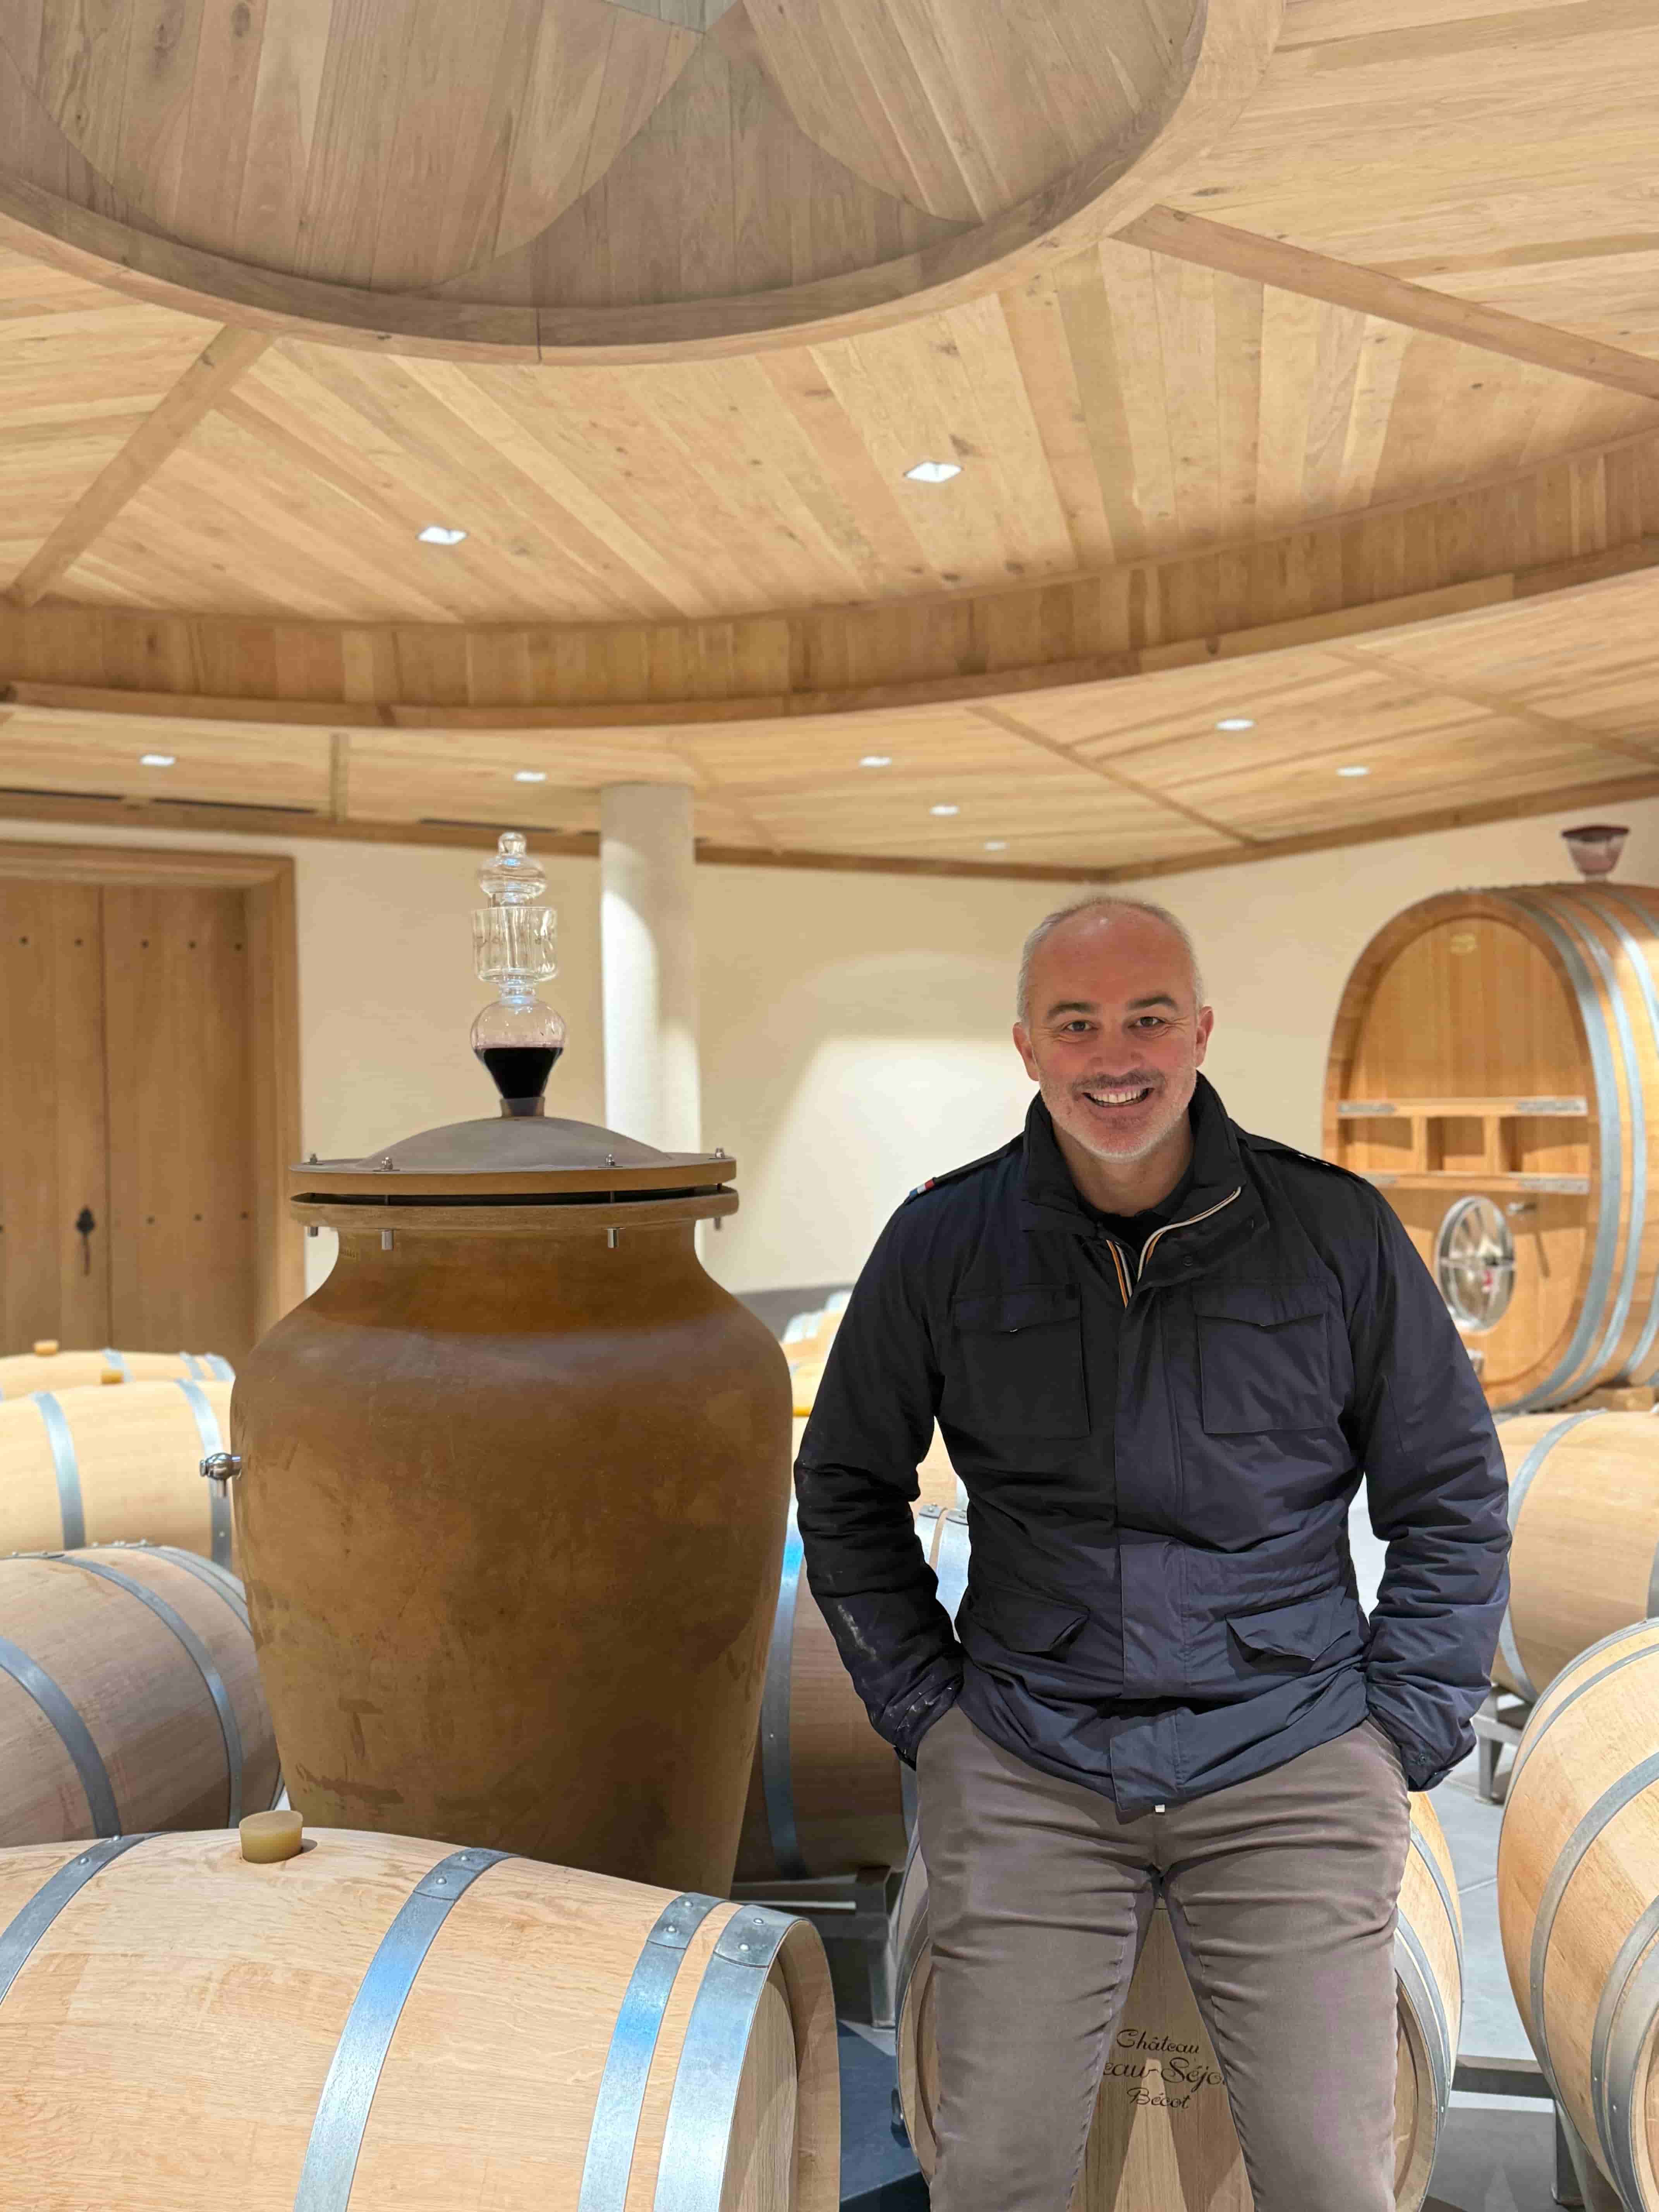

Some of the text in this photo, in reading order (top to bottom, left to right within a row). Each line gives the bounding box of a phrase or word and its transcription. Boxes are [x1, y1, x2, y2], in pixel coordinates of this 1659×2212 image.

[1116, 2029, 1199, 2053] Château
[1103, 2057, 1226, 2093] eau-Séjo
[1127, 2087, 1191, 2109] Bécot
